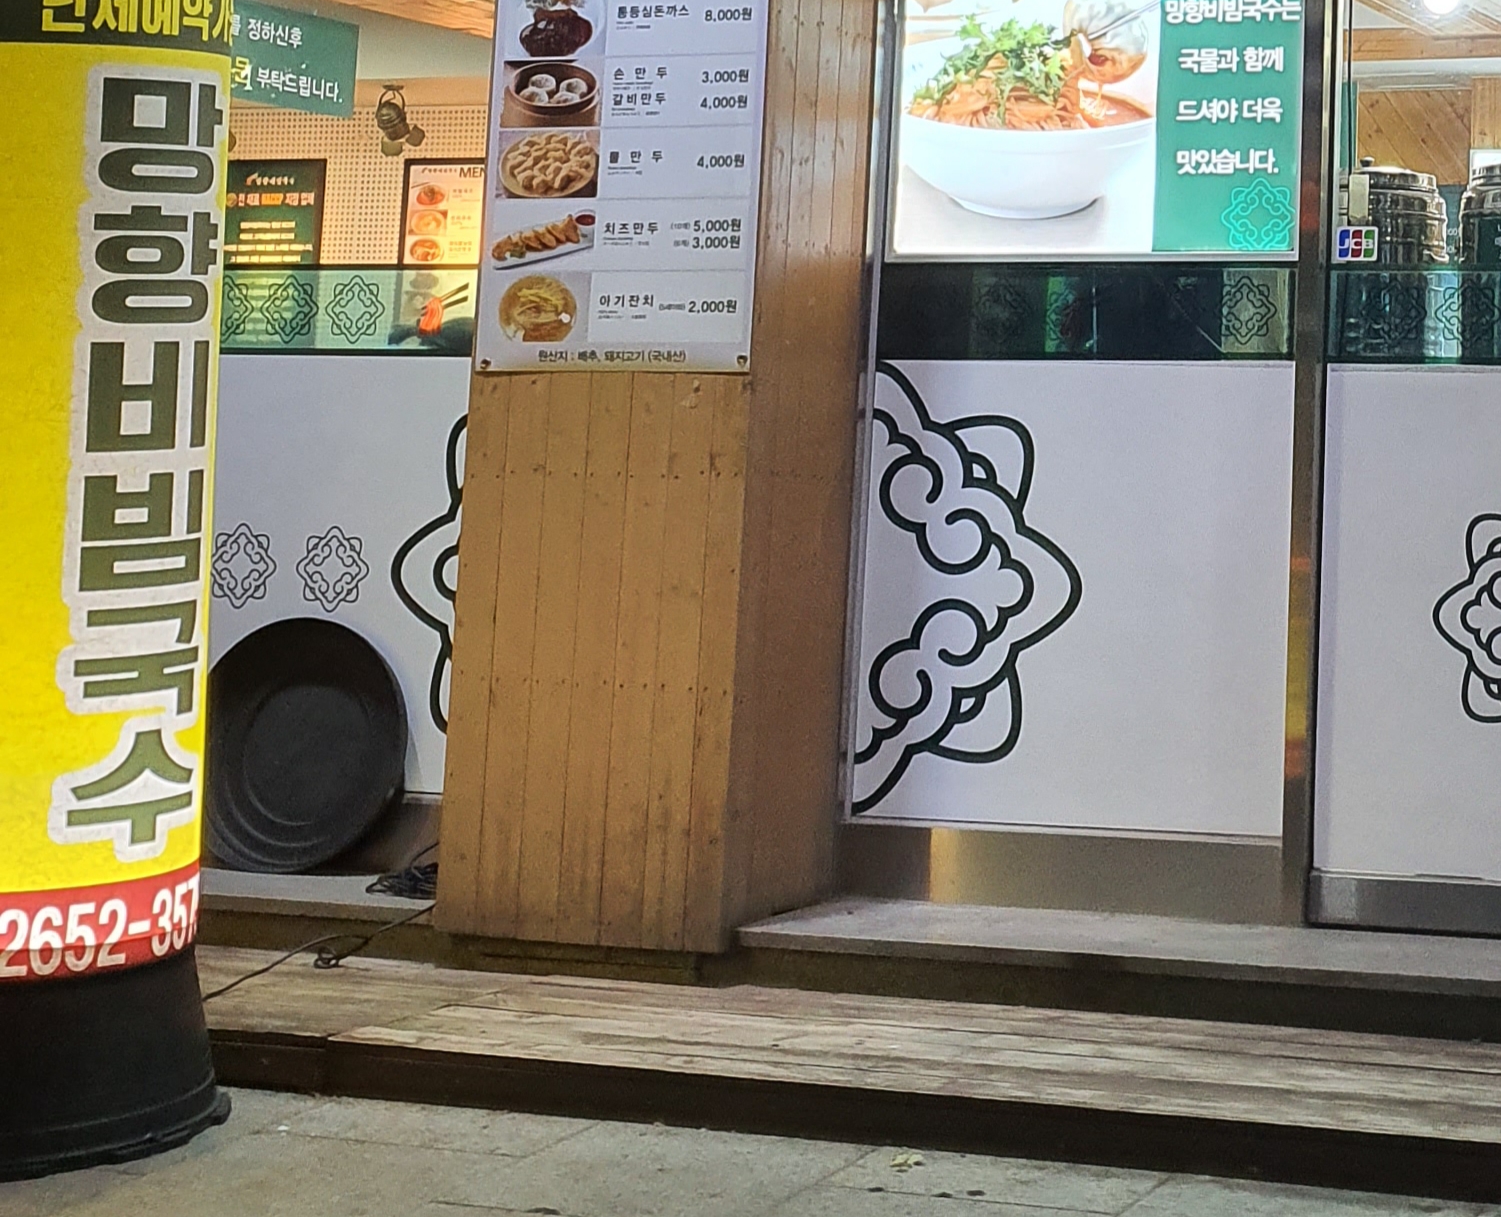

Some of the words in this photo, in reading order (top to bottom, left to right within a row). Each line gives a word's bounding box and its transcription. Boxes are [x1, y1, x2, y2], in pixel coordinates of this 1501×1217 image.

[704, 7, 753, 23] 8,000원
[247, 18, 303, 48] 정하신후
[1178, 48, 1239, 74] 국물과
[1243, 46, 1285, 73] 함께
[256, 67, 344, 104] 부탁드립니다.
[701, 68, 750, 84] 3,000원
[612, 92, 667, 106] 갈비만두
[700, 94, 749, 110] 4,000원
[1175, 98, 1239, 125] 드셔야
[1242, 96, 1284, 124] 더욱
[696, 153, 745, 169] 4,000원
[1176, 148, 1280, 177] 맛있습니다.
[603, 221, 659, 235] 치즈만두
[693, 218, 742, 234] 5,000원
[692, 236, 741, 251] 3,000원
[599, 294, 655, 309] 아기잔치
[688, 299, 738, 314] 2,000원
[537, 349, 568, 363] 원산지
[647, 349, 687, 363] (국내산)
[62, 72, 225, 850] 망향비빔국수
[0, 872, 200, 978] 2652-357
